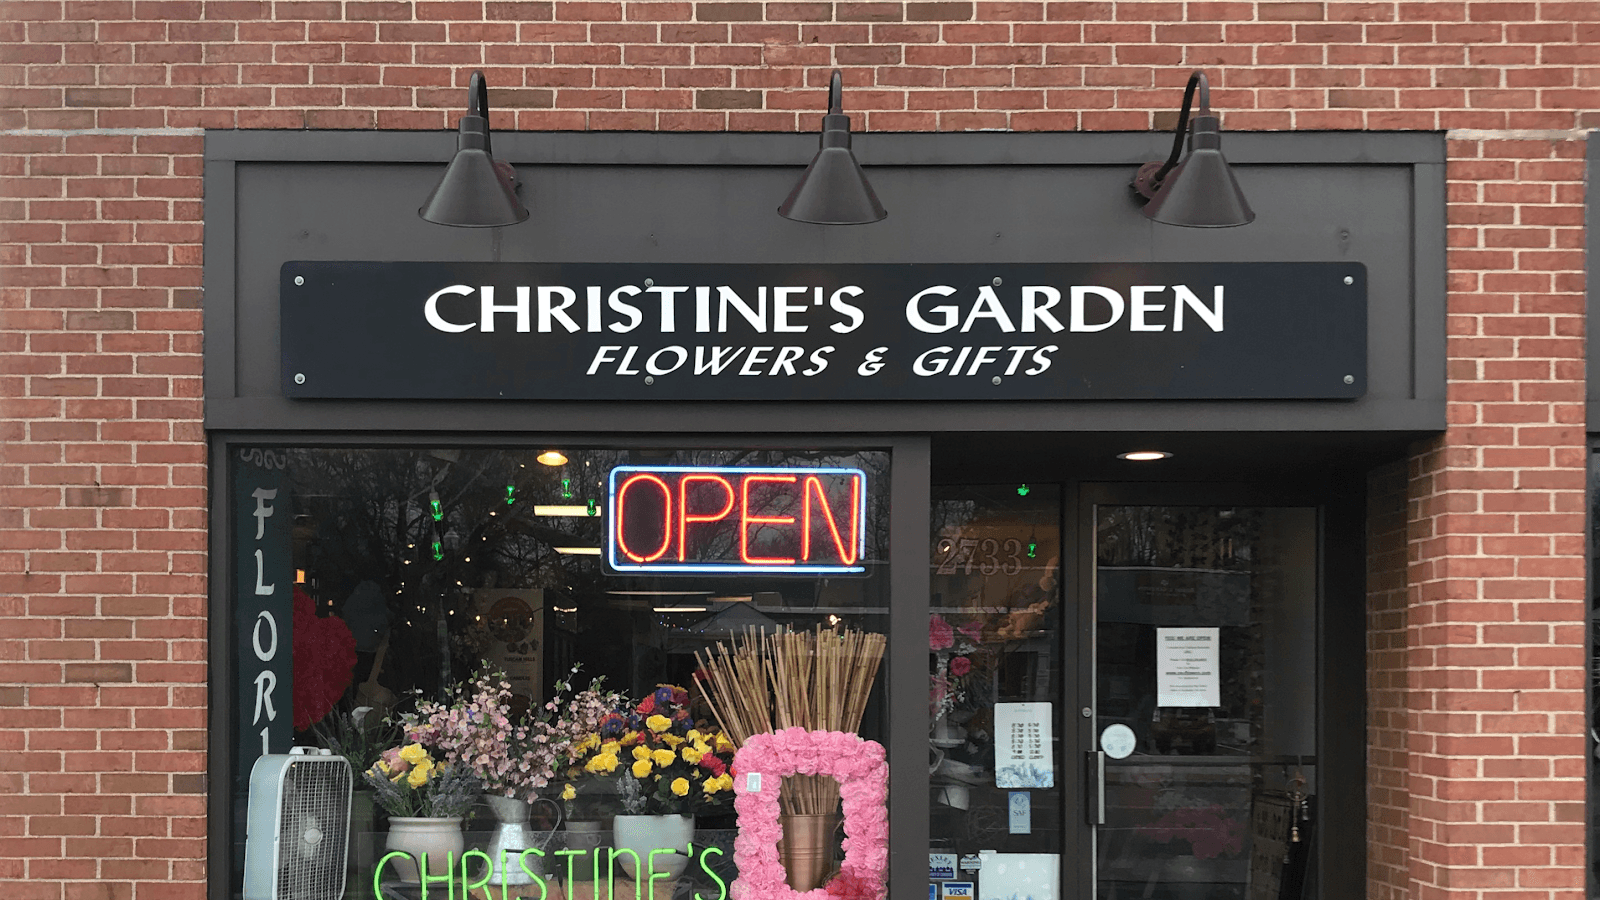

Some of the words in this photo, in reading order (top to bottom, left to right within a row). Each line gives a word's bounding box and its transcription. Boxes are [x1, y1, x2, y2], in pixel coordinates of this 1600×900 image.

[424, 284, 865, 334] CHRISTINE'S
[905, 284, 1224, 334] GARDEN
[586, 345, 836, 377] FLOWERS
[857, 346, 889, 376] &
[912, 345, 1060, 377] GIFTS
[616, 472, 861, 566] OPEN
[936, 538, 1022, 576] 2733
[373, 842, 727, 900] CHRISTINE'S
